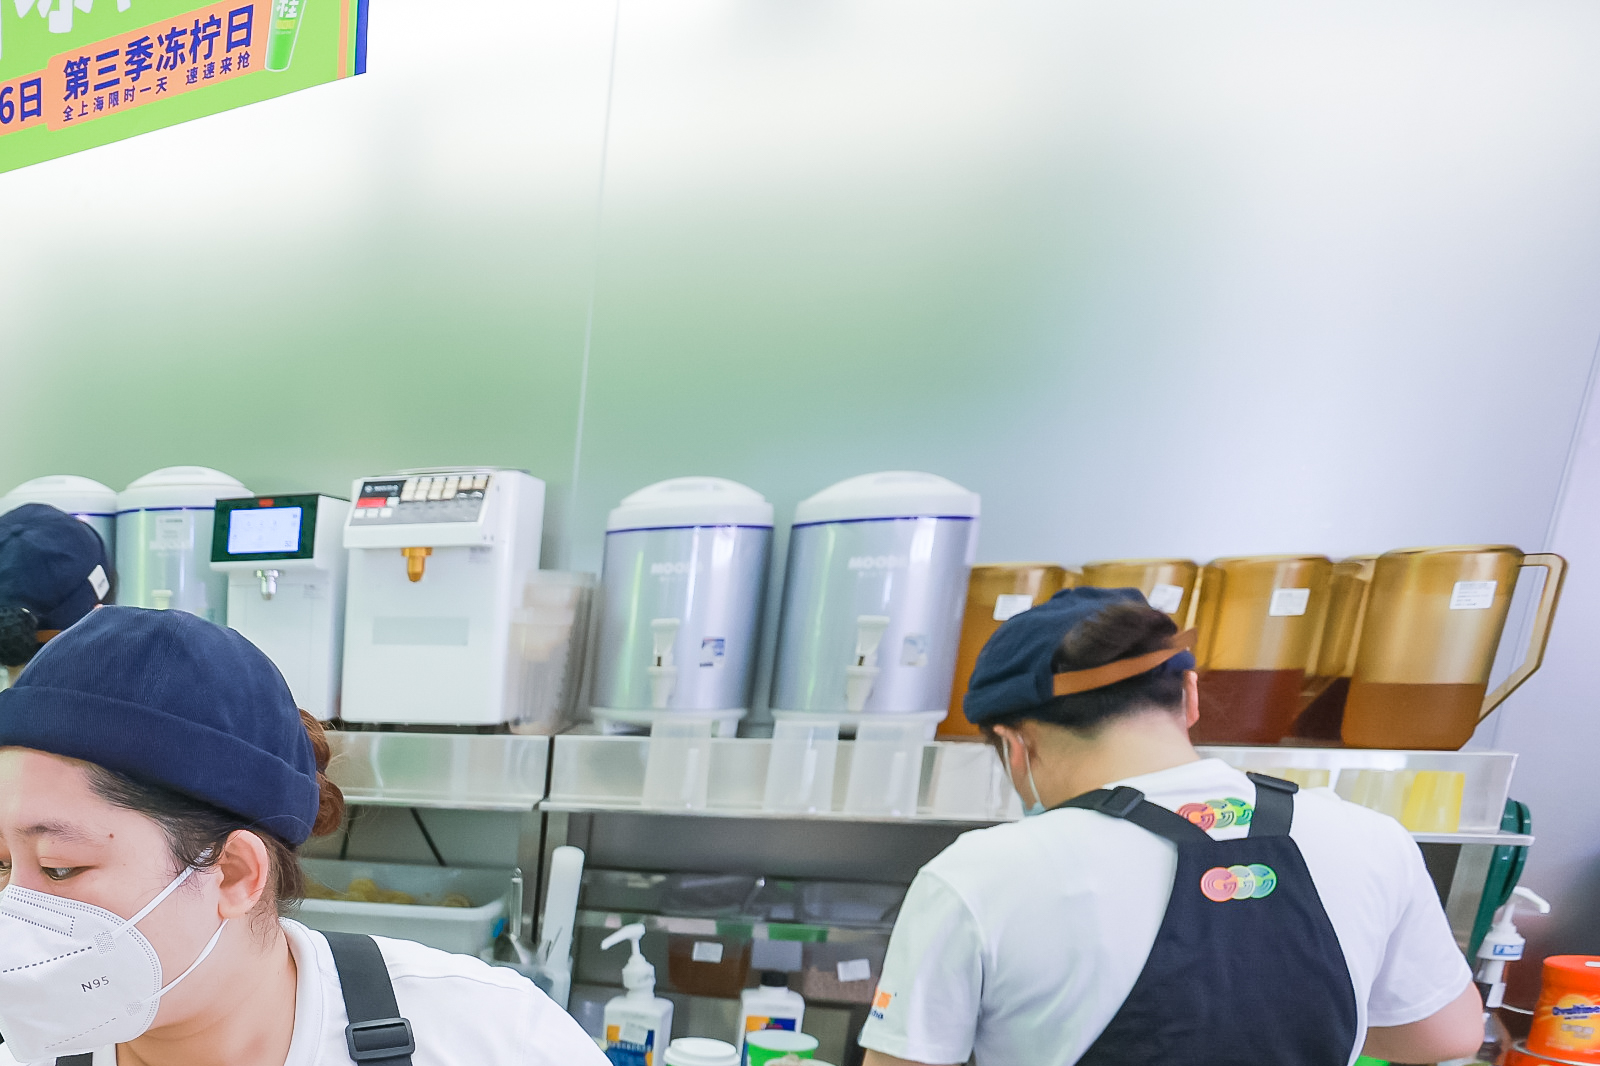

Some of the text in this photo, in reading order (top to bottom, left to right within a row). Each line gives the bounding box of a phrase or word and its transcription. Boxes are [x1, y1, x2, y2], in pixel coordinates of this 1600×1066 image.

[63, 4, 254, 101] 第三季冻柠日
[63, 51, 251, 122] 全上海限时一天 速速来抢
[81, 976, 110, 992] N95
